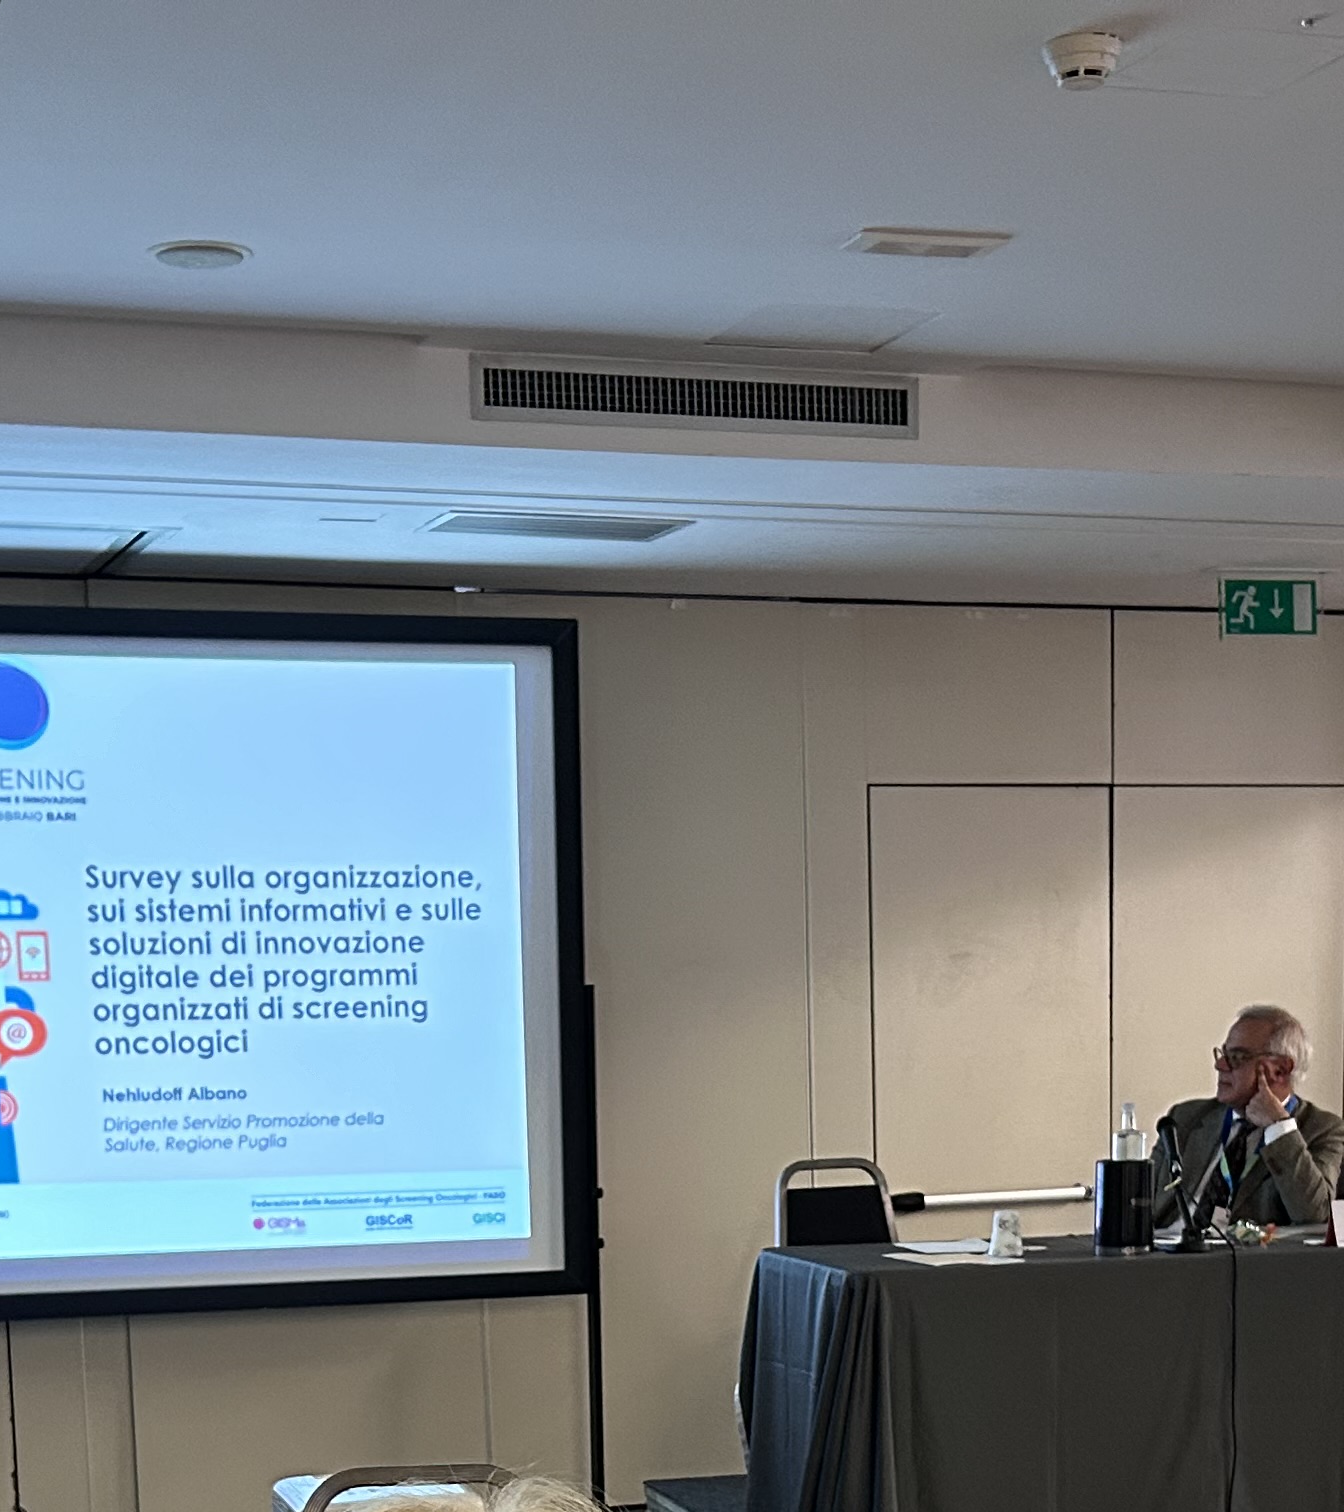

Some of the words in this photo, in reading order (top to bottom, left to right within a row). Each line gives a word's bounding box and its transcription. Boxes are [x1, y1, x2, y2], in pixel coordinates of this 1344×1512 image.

[46, 811, 76, 821] BARI
[85, 863, 182, 894] Survey
[191, 864, 255, 889] sulla
[265, 863, 482, 894] organizzazione,
[87, 898, 126, 923] sui
[135, 898, 231, 922] sistemi
[240, 897, 385, 922] informativi
[395, 903, 413, 921] e
[421, 898, 482, 921] sulle
[89, 931, 211, 956] soluzioni
[221, 931, 246, 955] di
[256, 929, 425, 954] innovazione
[91, 964, 200, 995] digitale
[209, 963, 254, 988] dei
[263, 962, 418, 992] programmi
[93, 996, 248, 1027] organizzati
[258, 996, 283, 1020] di
[292, 994, 429, 1023] screening
[94, 1029, 248, 1059] oncologici
[102, 1087, 183, 1103] Nehludoff
[188, 1087, 247, 1101] Albano
[104, 1116, 178, 1134] Dirigente
[183, 1116, 241, 1130] Servizio
[247, 1113, 340, 1129] Promozione
[344, 1111, 384, 1126] della
[105, 1138, 160, 1153] Salute,
[166, 1136, 233, 1153] Regione
[239, 1134, 287, 1151] Puglia
[365, 1214, 413, 1227] GISCoR
